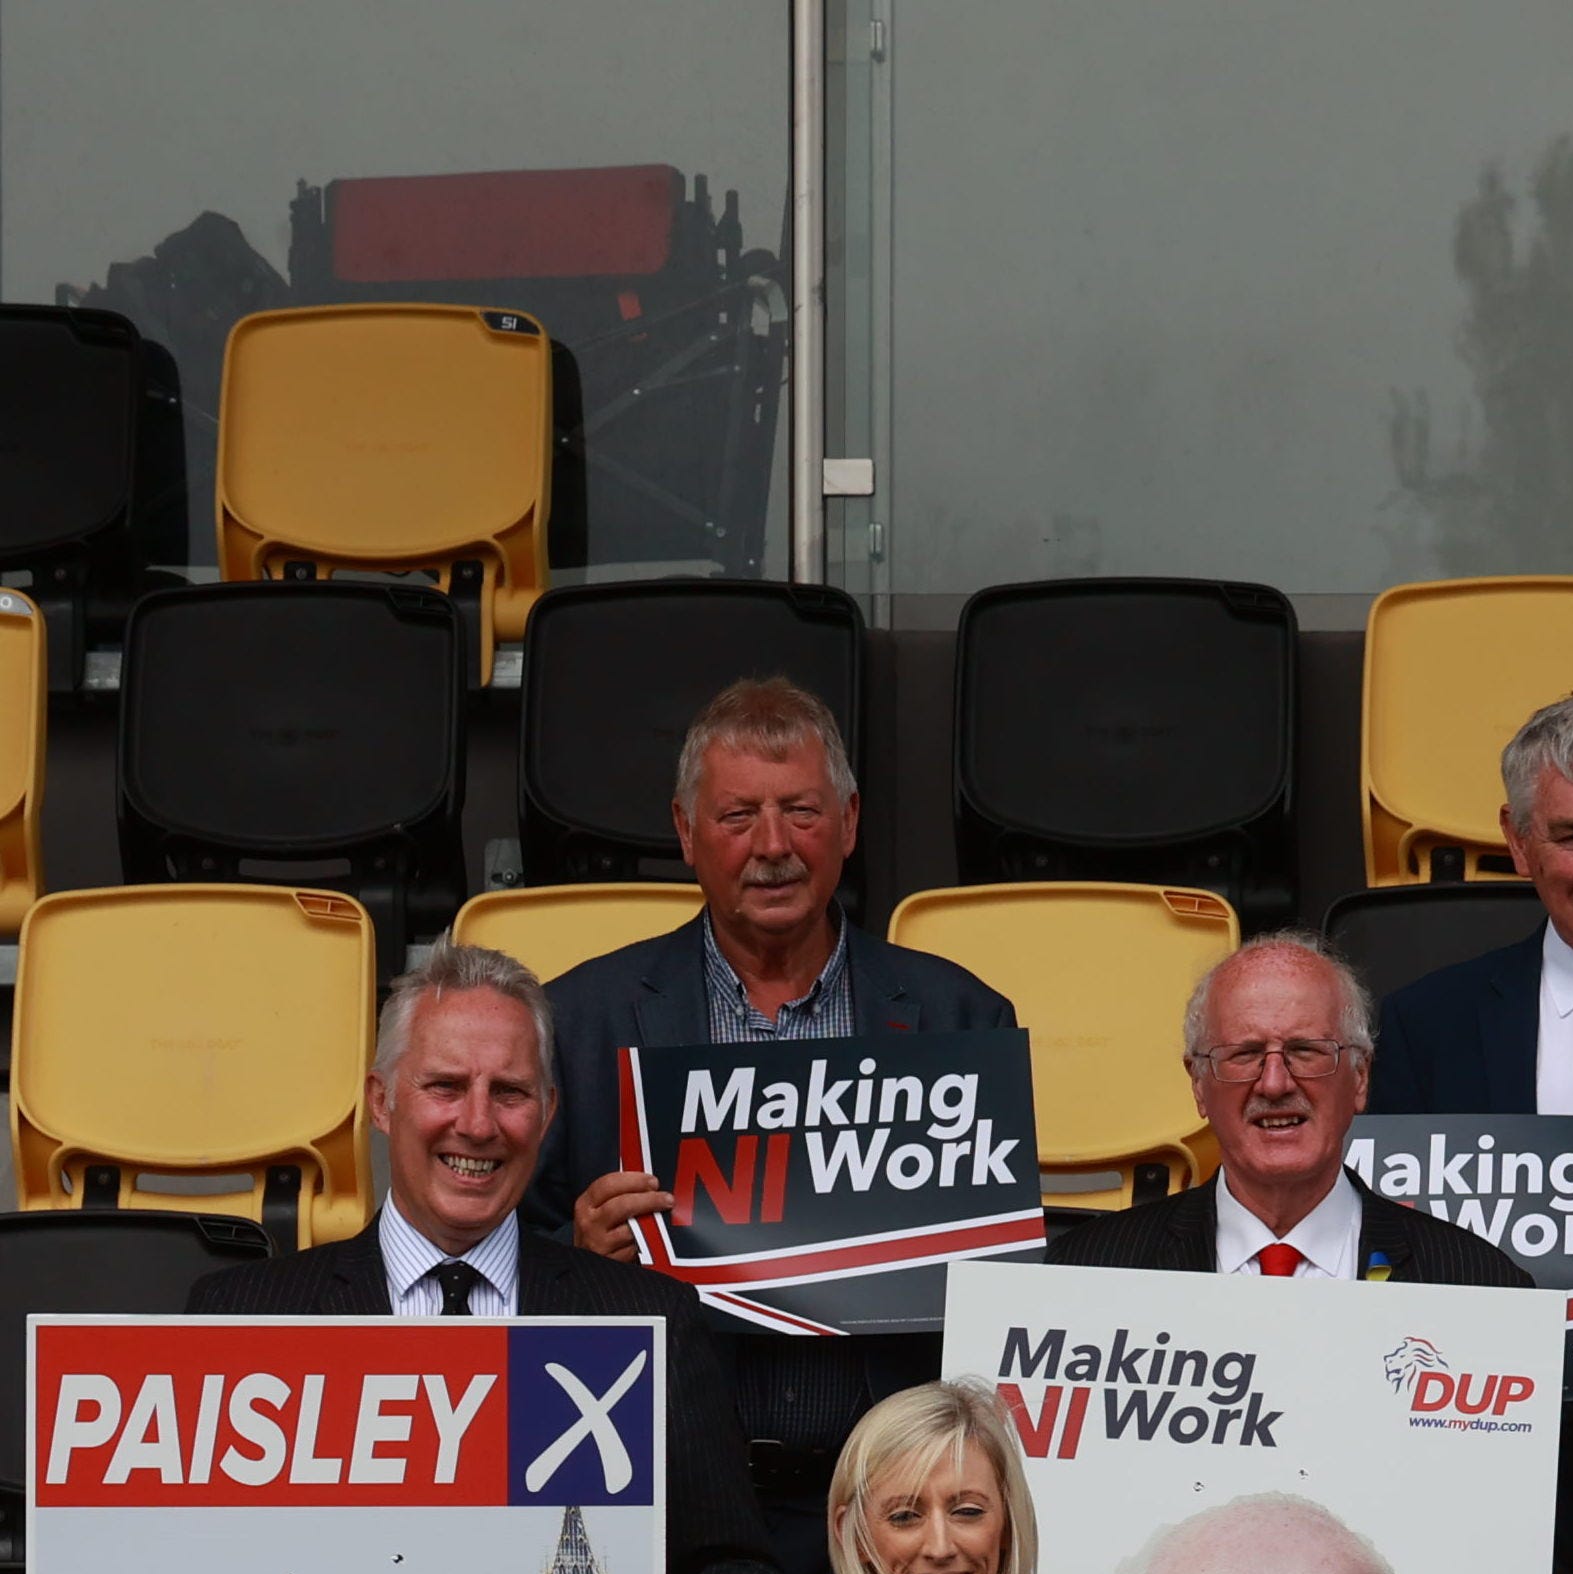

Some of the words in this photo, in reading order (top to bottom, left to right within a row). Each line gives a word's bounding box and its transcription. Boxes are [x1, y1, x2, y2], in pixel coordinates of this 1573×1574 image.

[501, 316, 517, 329] 51
[680, 1058, 978, 1140] Making
[671, 1133, 791, 1226] NI
[805, 1119, 1019, 1194] Work
[1000, 1327, 1256, 1404] Making
[1411, 1371, 1535, 1417] DUP
[45, 1373, 498, 1486] PAISLEY
[995, 1383, 1093, 1460] NI
[1104, 1392, 1283, 1448] Work
[1408, 1416, 1533, 1434] www.mydup.com
